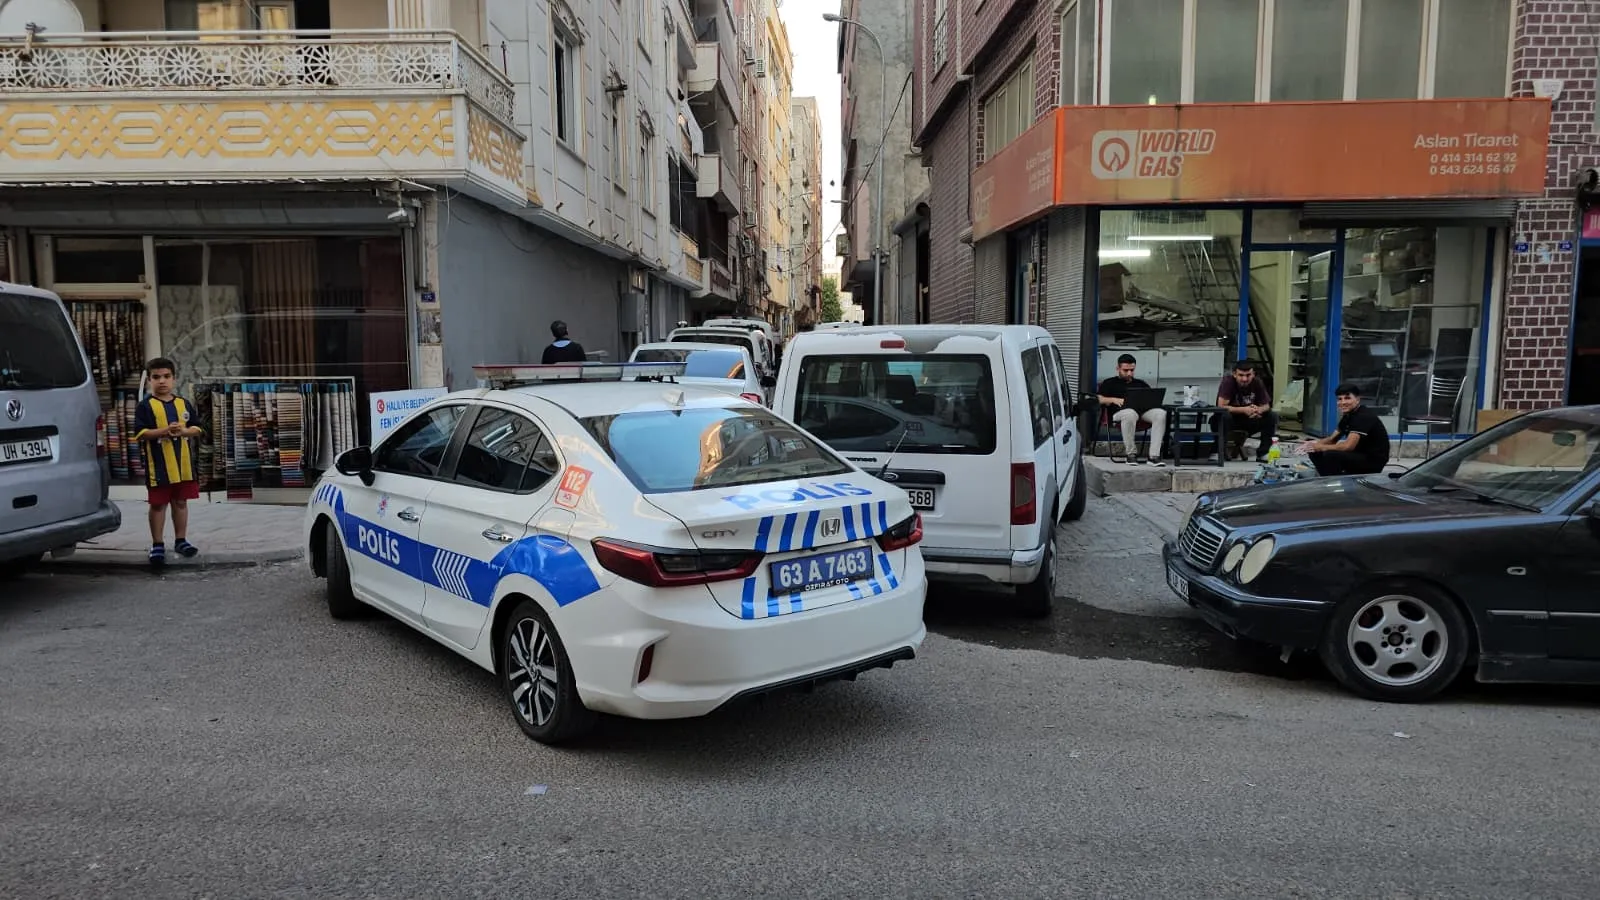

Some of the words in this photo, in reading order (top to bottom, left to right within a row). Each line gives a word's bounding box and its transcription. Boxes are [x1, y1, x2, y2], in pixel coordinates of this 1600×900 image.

[1138, 130, 1215, 153] WORLD
[1414, 133, 1460, 148] Aslan
[1463, 132, 1519, 147] Ticaret
[1138, 156, 1182, 177] GAS
[1430, 154, 1438, 163] 0
[1441, 153, 1461, 162] 414
[1463, 153, 1483, 162] 314
[1430, 165, 1437, 175] 0
[1440, 165, 1461, 174] 543
[380, 418, 392, 429] FEN
[3, 444, 18, 460] UH
[20, 440, 48, 458] 4394
[565, 470, 587, 491] 112
[720, 482, 873, 510] POLİS
[908, 490, 931, 506] 568
[701, 529, 740, 539] CITY
[358, 523, 401, 566] POLİS
[780, 563, 803, 588] 63
[808, 560, 823, 582] A
[825, 551, 867, 579] 7463
[835, 577, 850, 585] OTO
